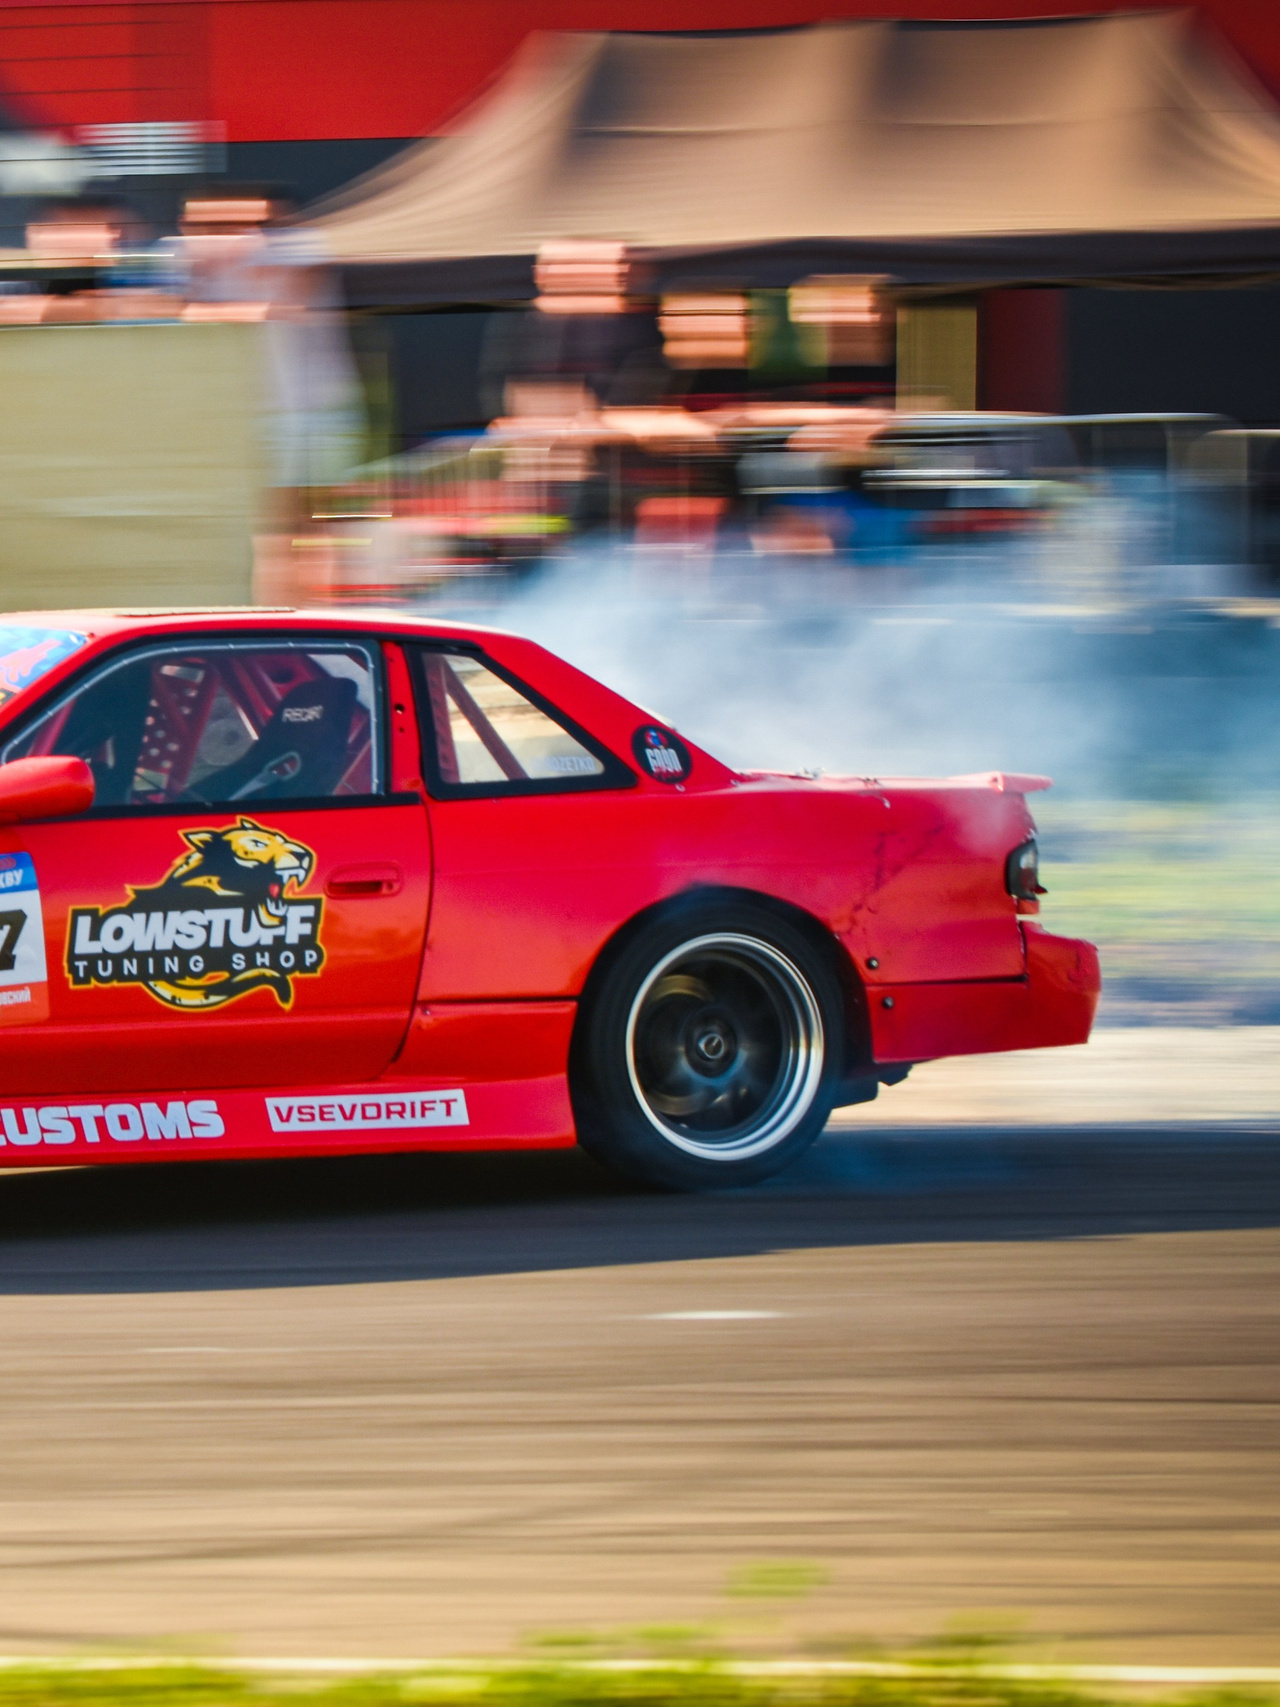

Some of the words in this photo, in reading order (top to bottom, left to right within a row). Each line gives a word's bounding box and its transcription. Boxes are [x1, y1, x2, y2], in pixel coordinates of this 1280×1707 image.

[73, 904, 316, 955] LOWSTUFF
[74, 954, 205, 978] TUNING
[231, 950, 318, 971] SHOP
[274, 1098, 458, 1124] VSEVDRIFT
